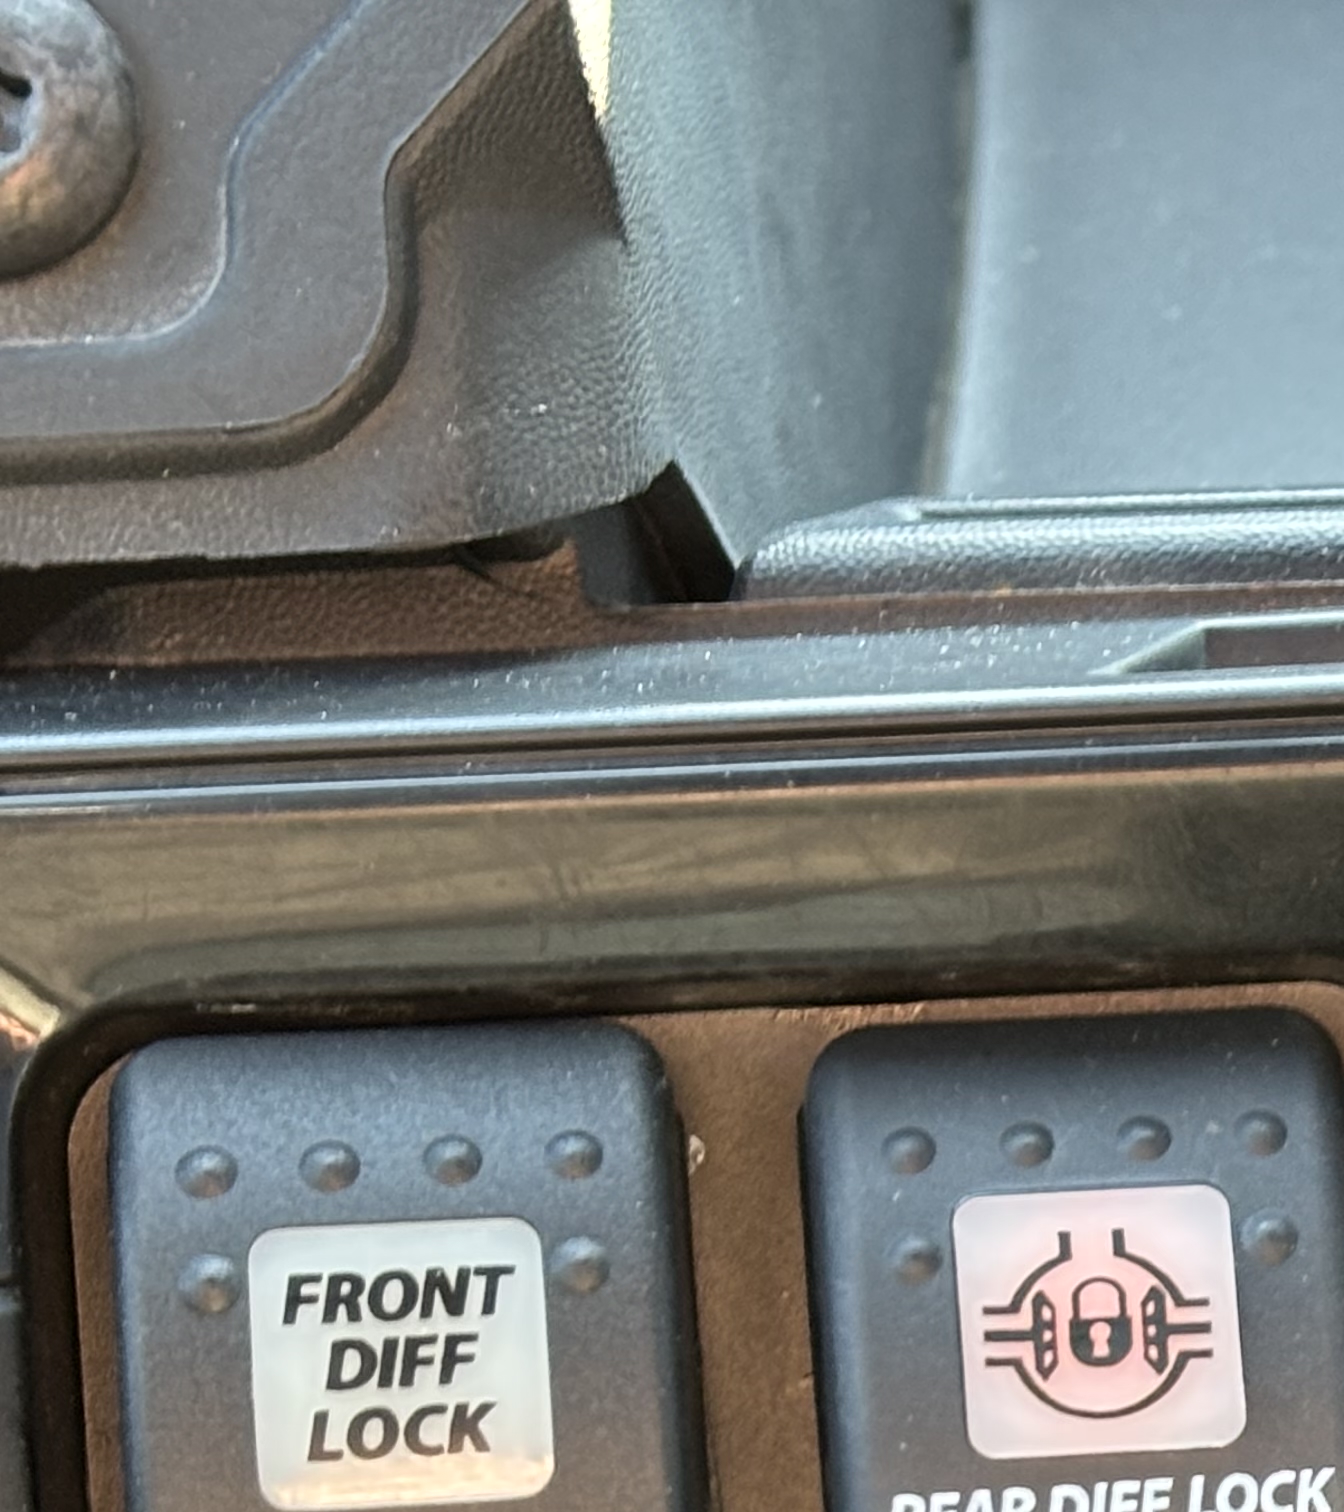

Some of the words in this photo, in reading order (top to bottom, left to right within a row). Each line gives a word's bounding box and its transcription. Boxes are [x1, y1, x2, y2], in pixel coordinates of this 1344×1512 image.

[281, 1264, 515, 1325] FRONT
[325, 1332, 480, 1391] DIFF
[306, 1401, 497, 1463] LOCK
